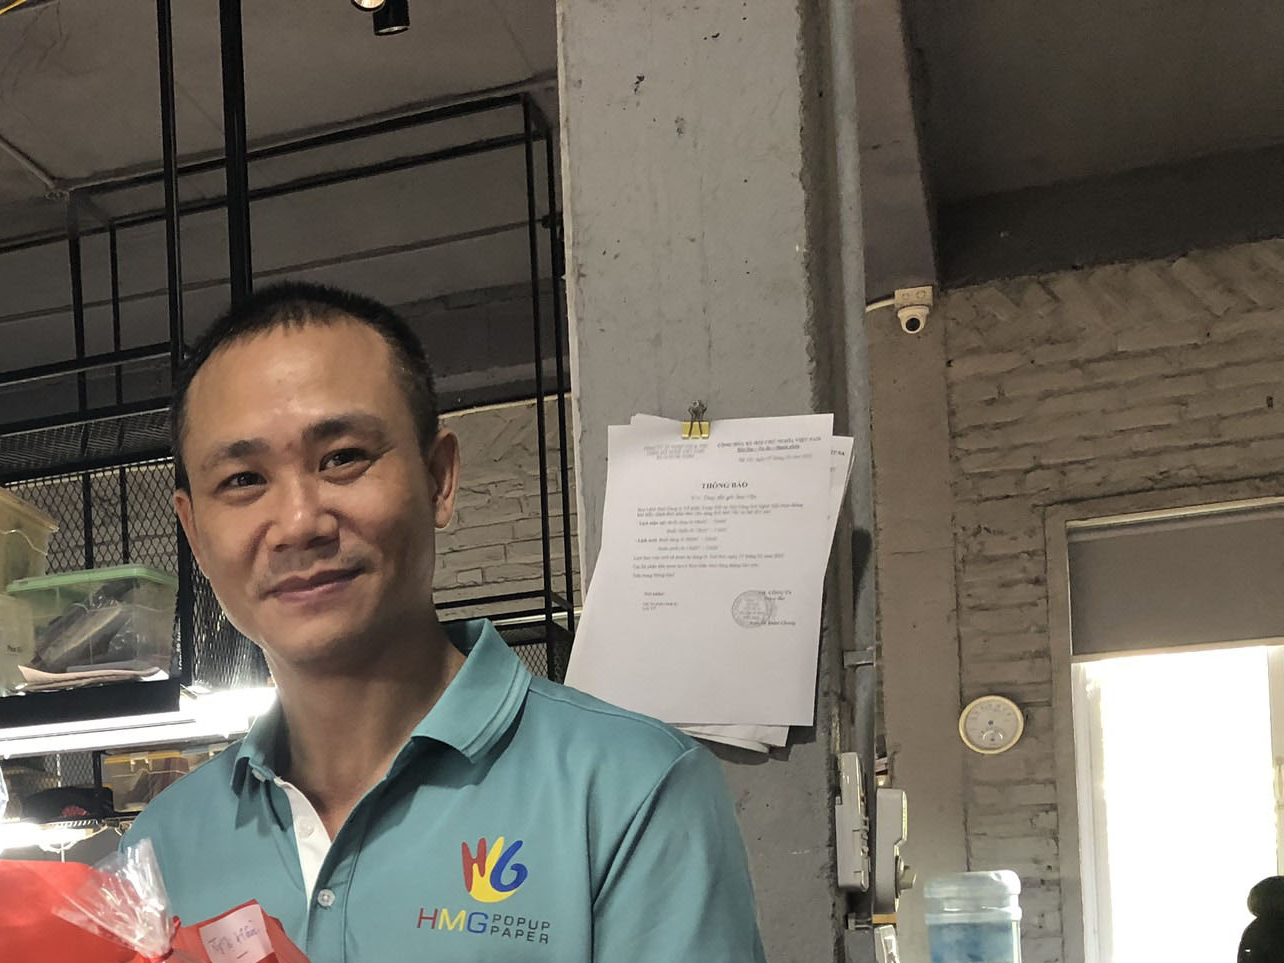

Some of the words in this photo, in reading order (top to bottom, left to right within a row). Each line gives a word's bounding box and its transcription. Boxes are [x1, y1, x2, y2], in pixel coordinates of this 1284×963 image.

[417, 908, 489, 933] HMG
[492, 914, 551, 931] POPUP
[490, 926, 549, 944] PAPER
